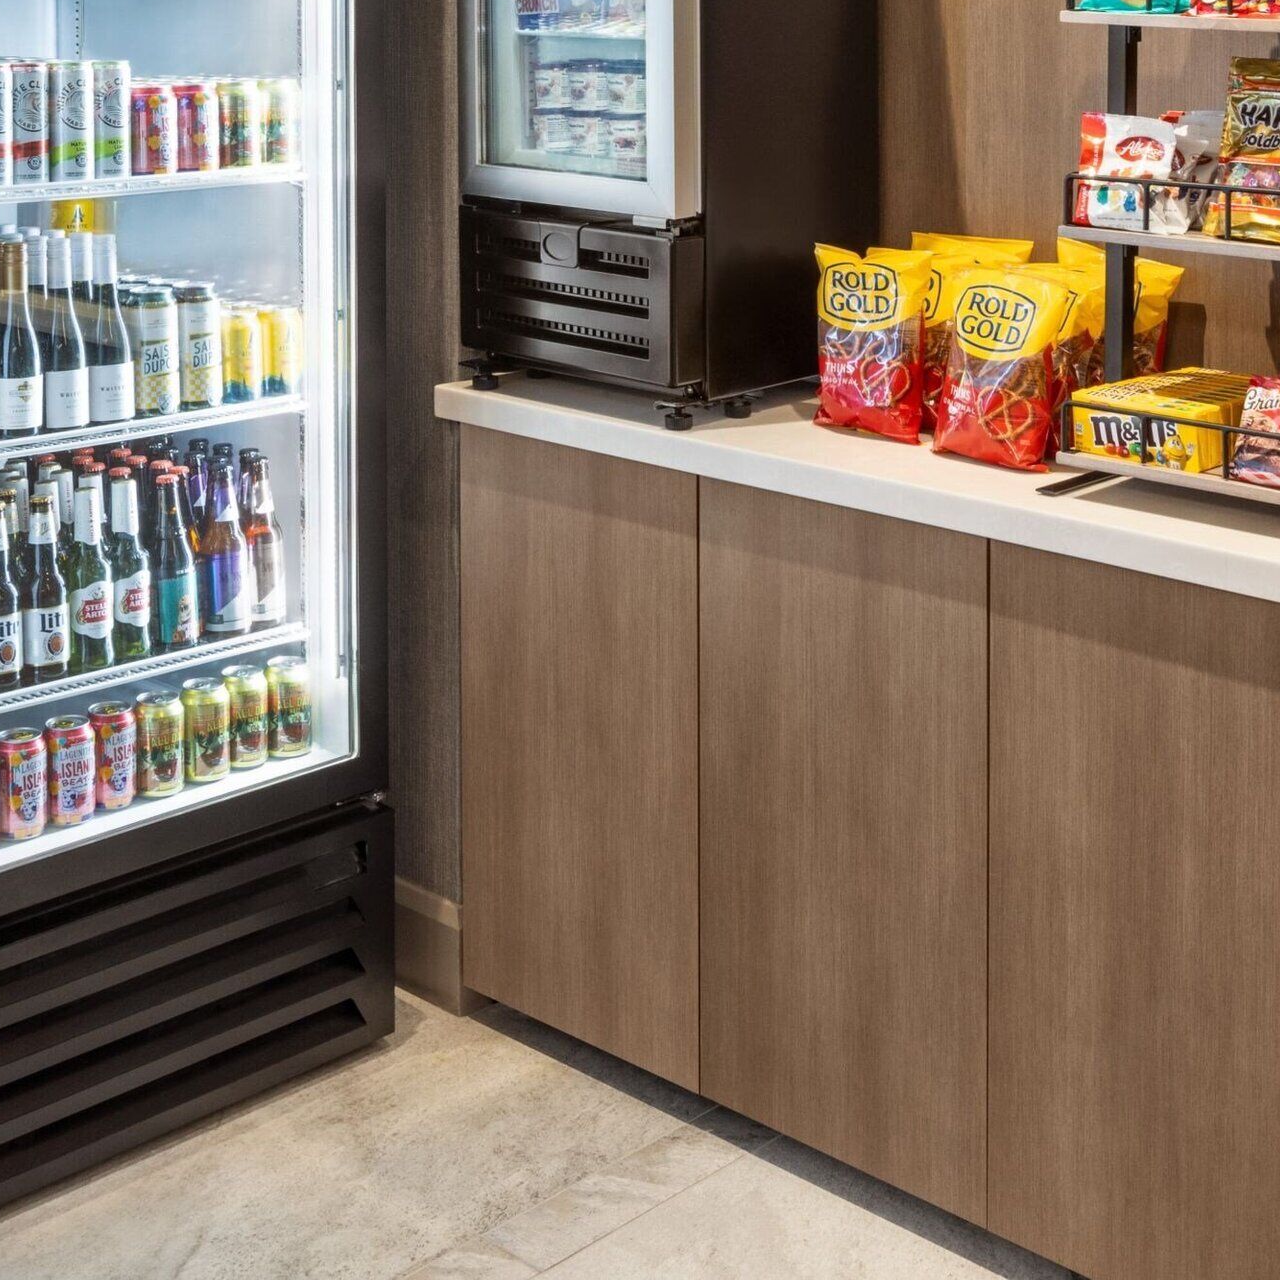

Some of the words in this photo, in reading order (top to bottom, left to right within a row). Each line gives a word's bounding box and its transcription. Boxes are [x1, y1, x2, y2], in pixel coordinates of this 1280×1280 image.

[832, 270, 891, 292] ROLD
[830, 294, 891, 315] GOLD
[969, 291, 1029, 323] ROLD
[961, 315, 1021, 346] GOLD
